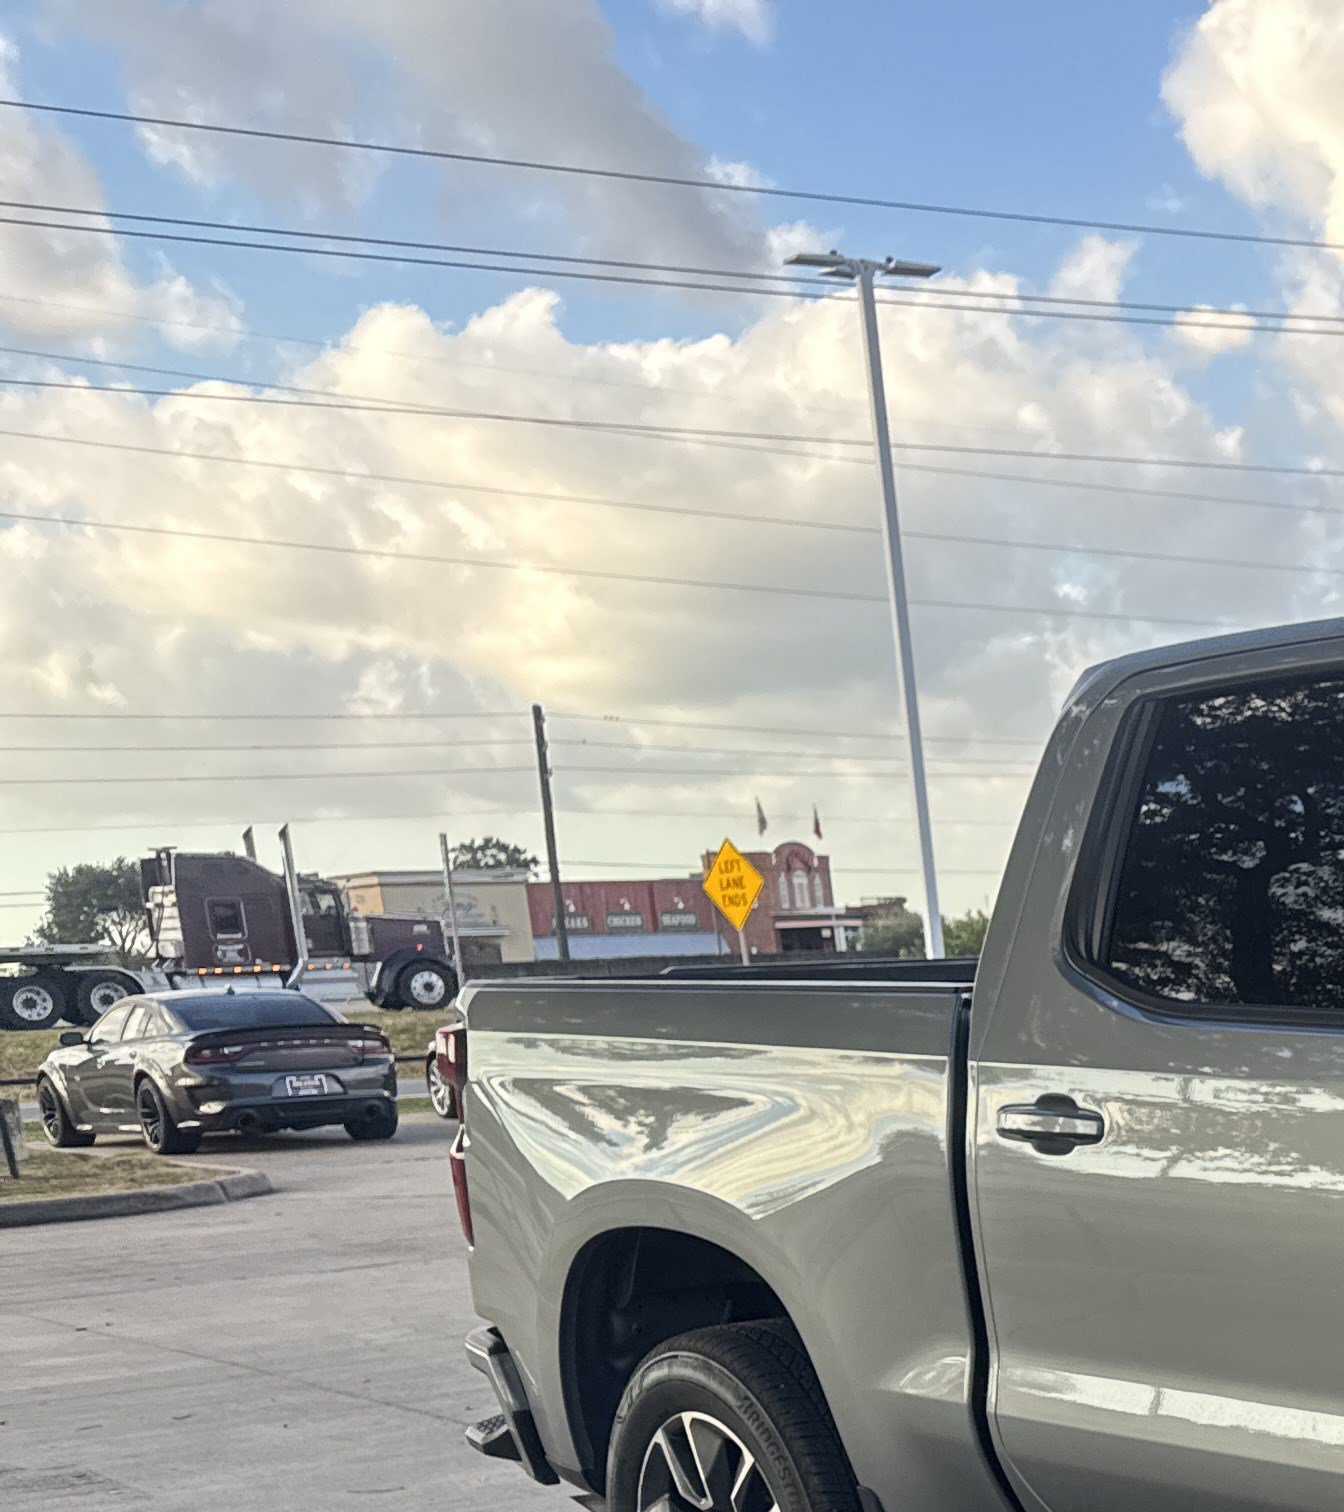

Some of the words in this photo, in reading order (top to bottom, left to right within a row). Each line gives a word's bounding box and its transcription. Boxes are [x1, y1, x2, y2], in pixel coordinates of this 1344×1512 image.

[718, 859, 741, 874] LEFT
[719, 875, 746, 891] LANE
[722, 893, 748, 907] ENDS
